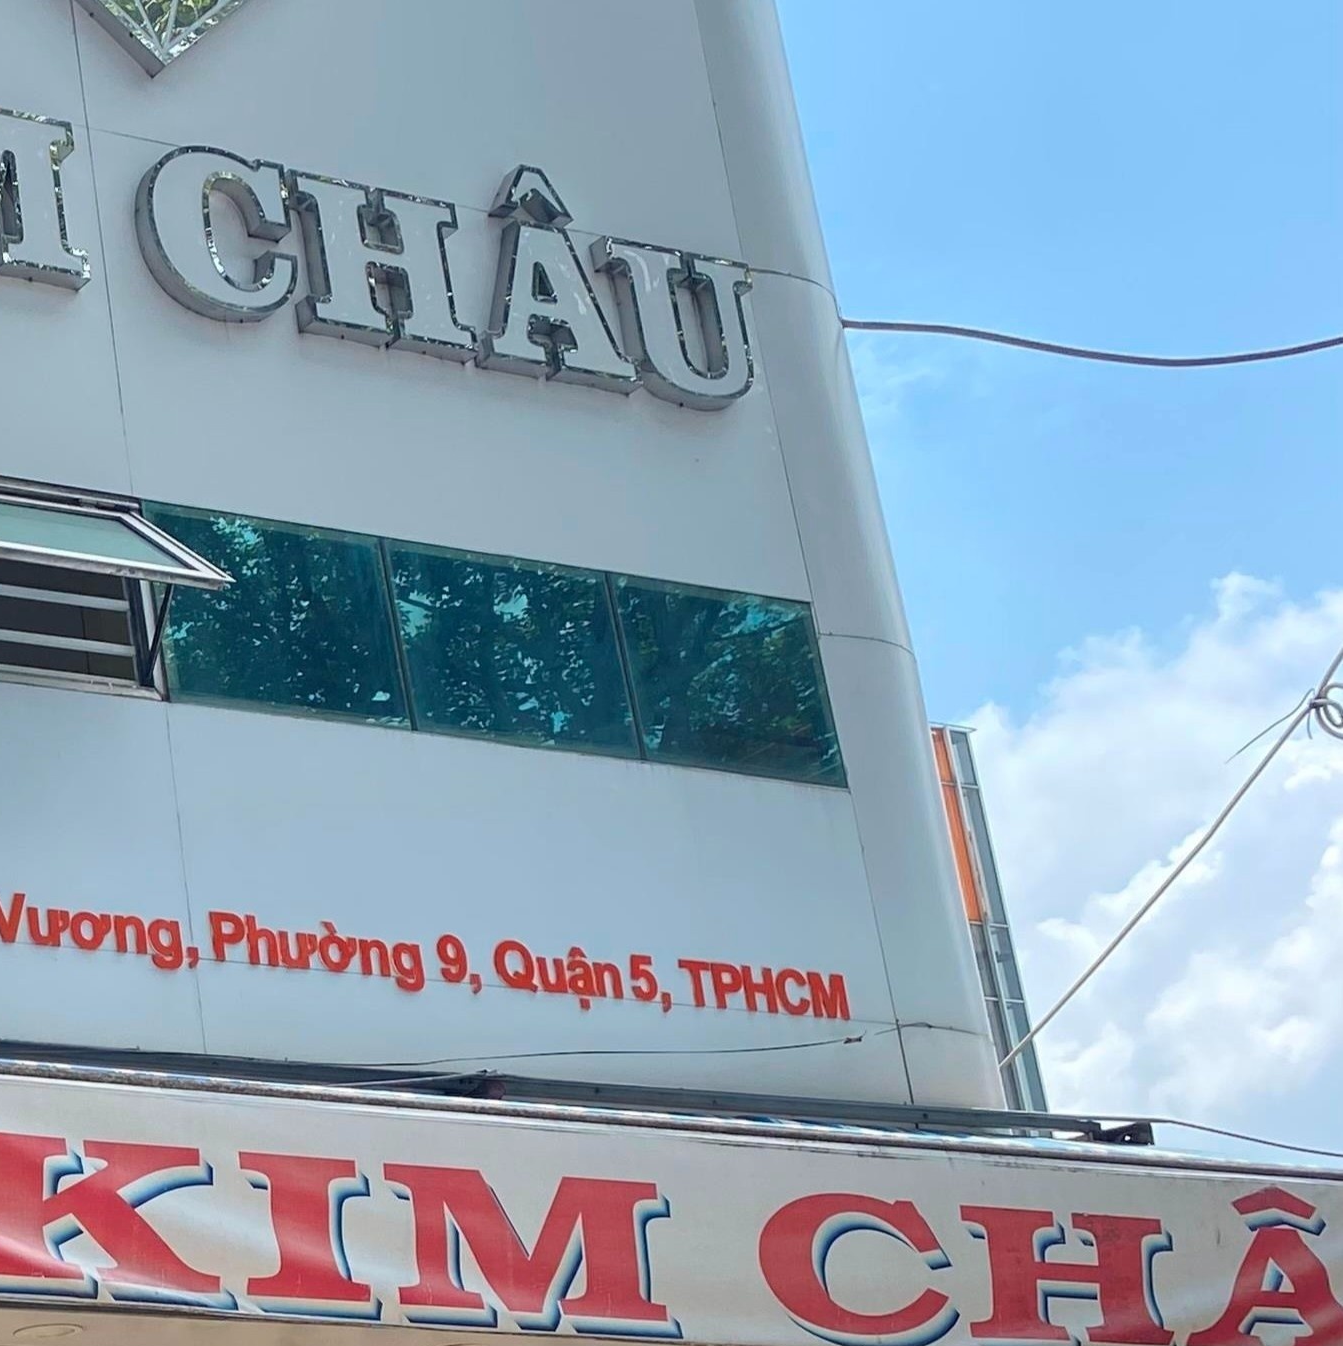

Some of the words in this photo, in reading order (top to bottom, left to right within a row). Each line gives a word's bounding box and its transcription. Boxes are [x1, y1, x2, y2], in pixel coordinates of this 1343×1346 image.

[134, 145, 754, 411] CHÂU
[209, 911, 425, 991] Phường
[436, 934, 482, 994] 9,
[493, 939, 623, 1010] Quận
[630, 955, 671, 1012] 5,
[677, 958, 851, 1020] TPHCM
